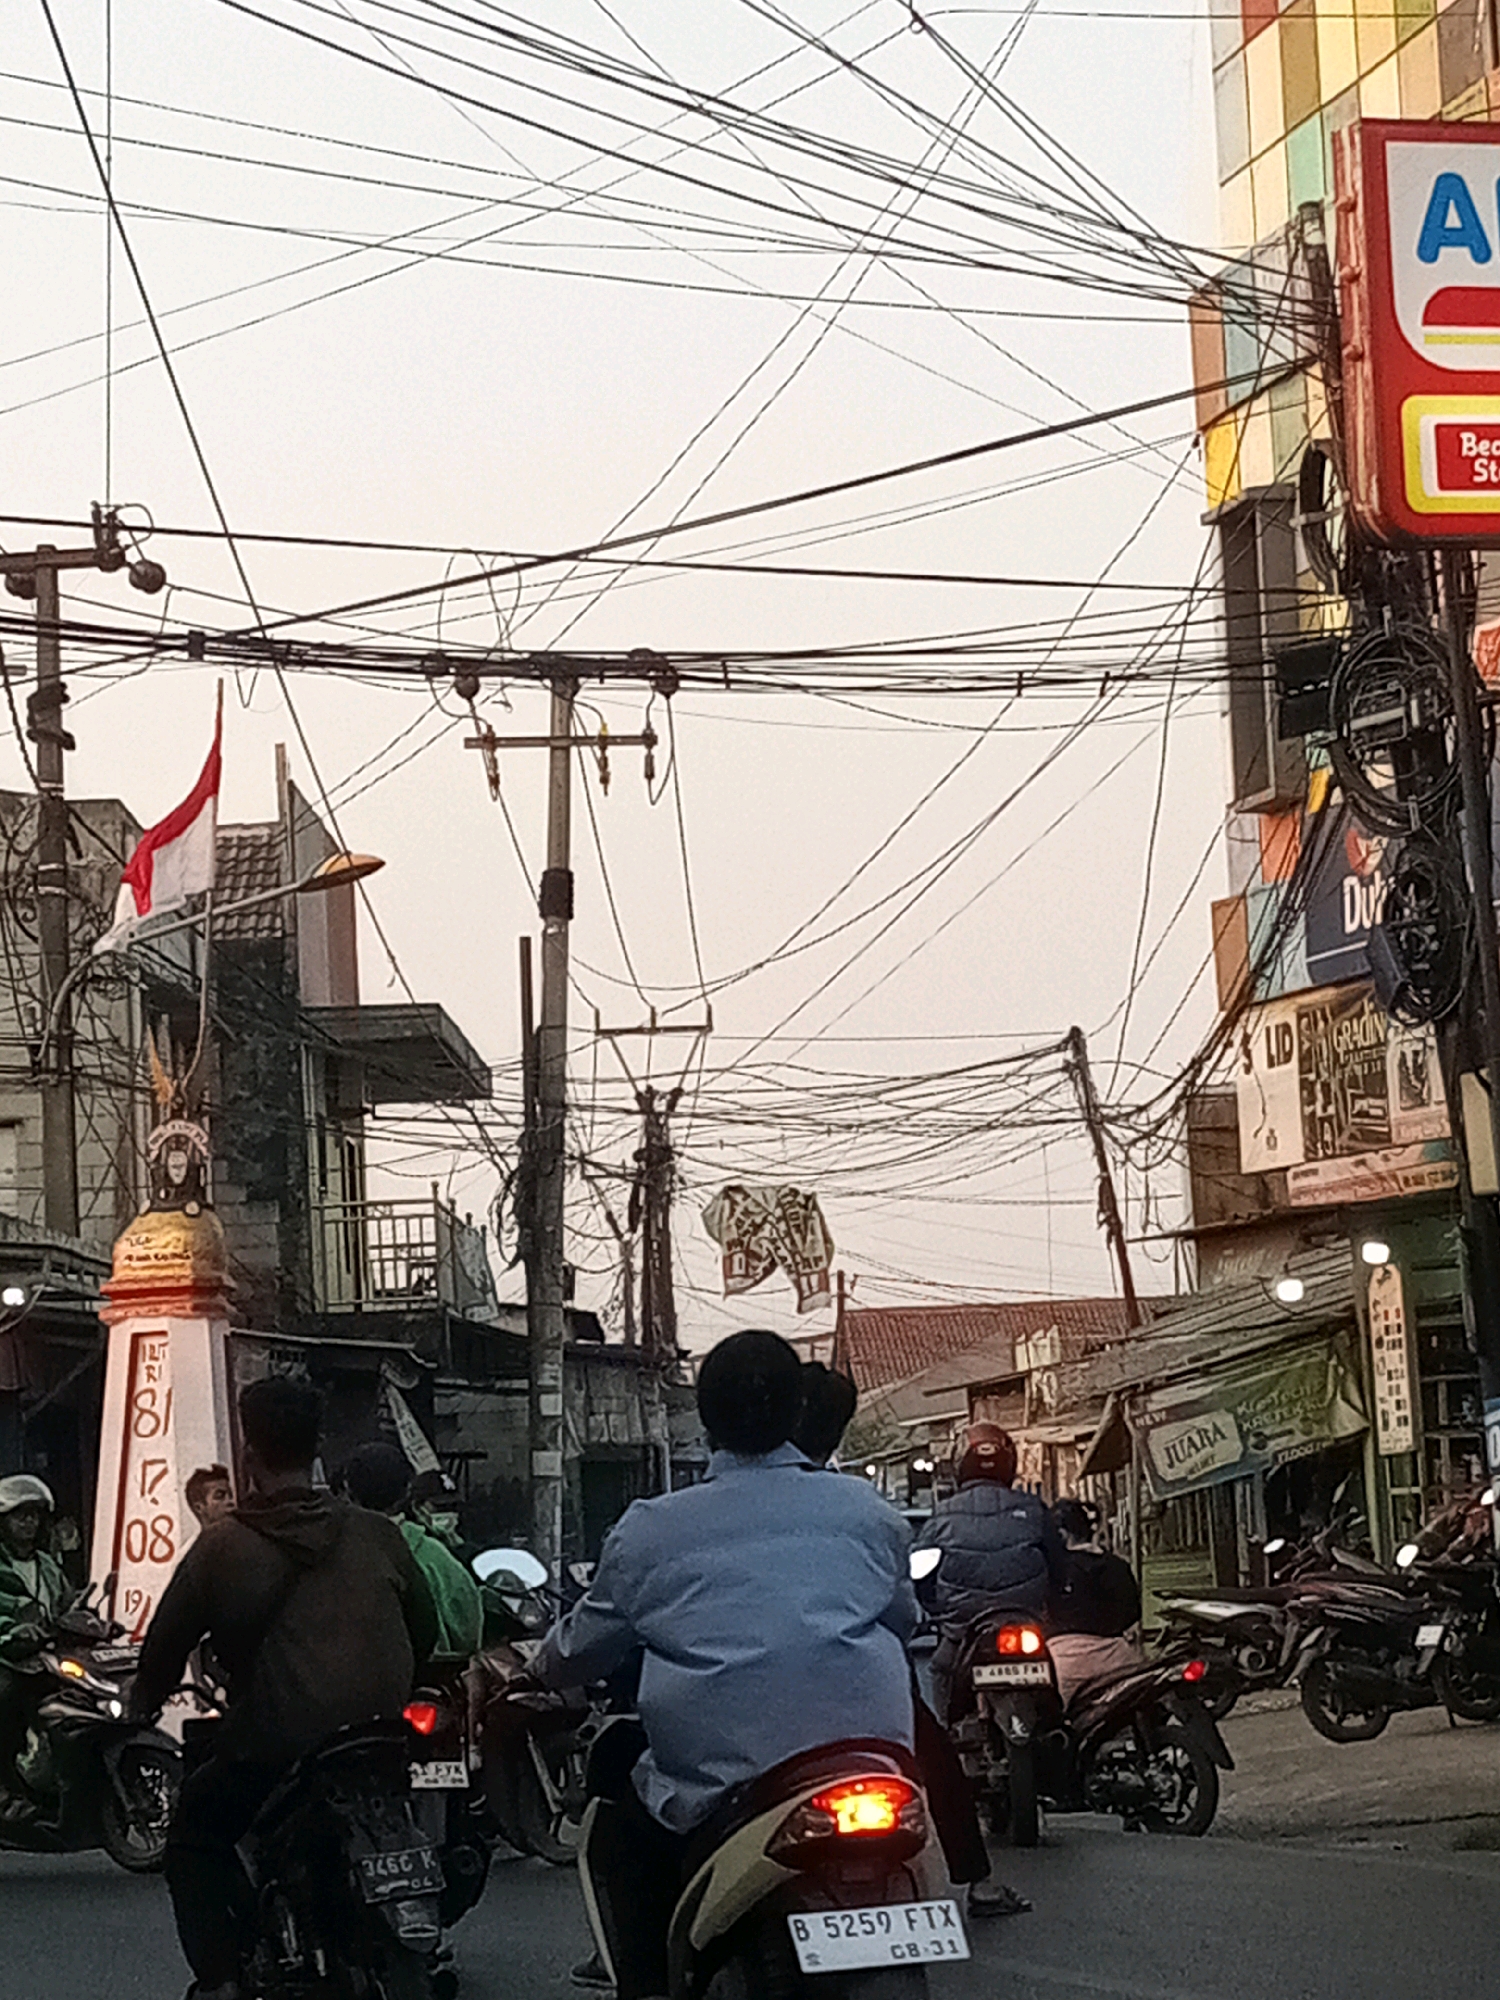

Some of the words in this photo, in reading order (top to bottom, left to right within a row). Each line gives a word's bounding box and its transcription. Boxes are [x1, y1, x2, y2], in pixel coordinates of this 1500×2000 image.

[1417, 172, 1500, 264] A
[1473, 457, 1500, 483] St
[133, 1387, 173, 1438] 81
[1135, 1411, 1166, 1427] NEW
[1163, 1421, 1228, 1469] JUARA
[126, 1514, 175, 1564] 08
[793, 1919, 810, 1941] B
[823, 1911, 892, 1938] 5259
[904, 1904, 956, 1931] FTX
